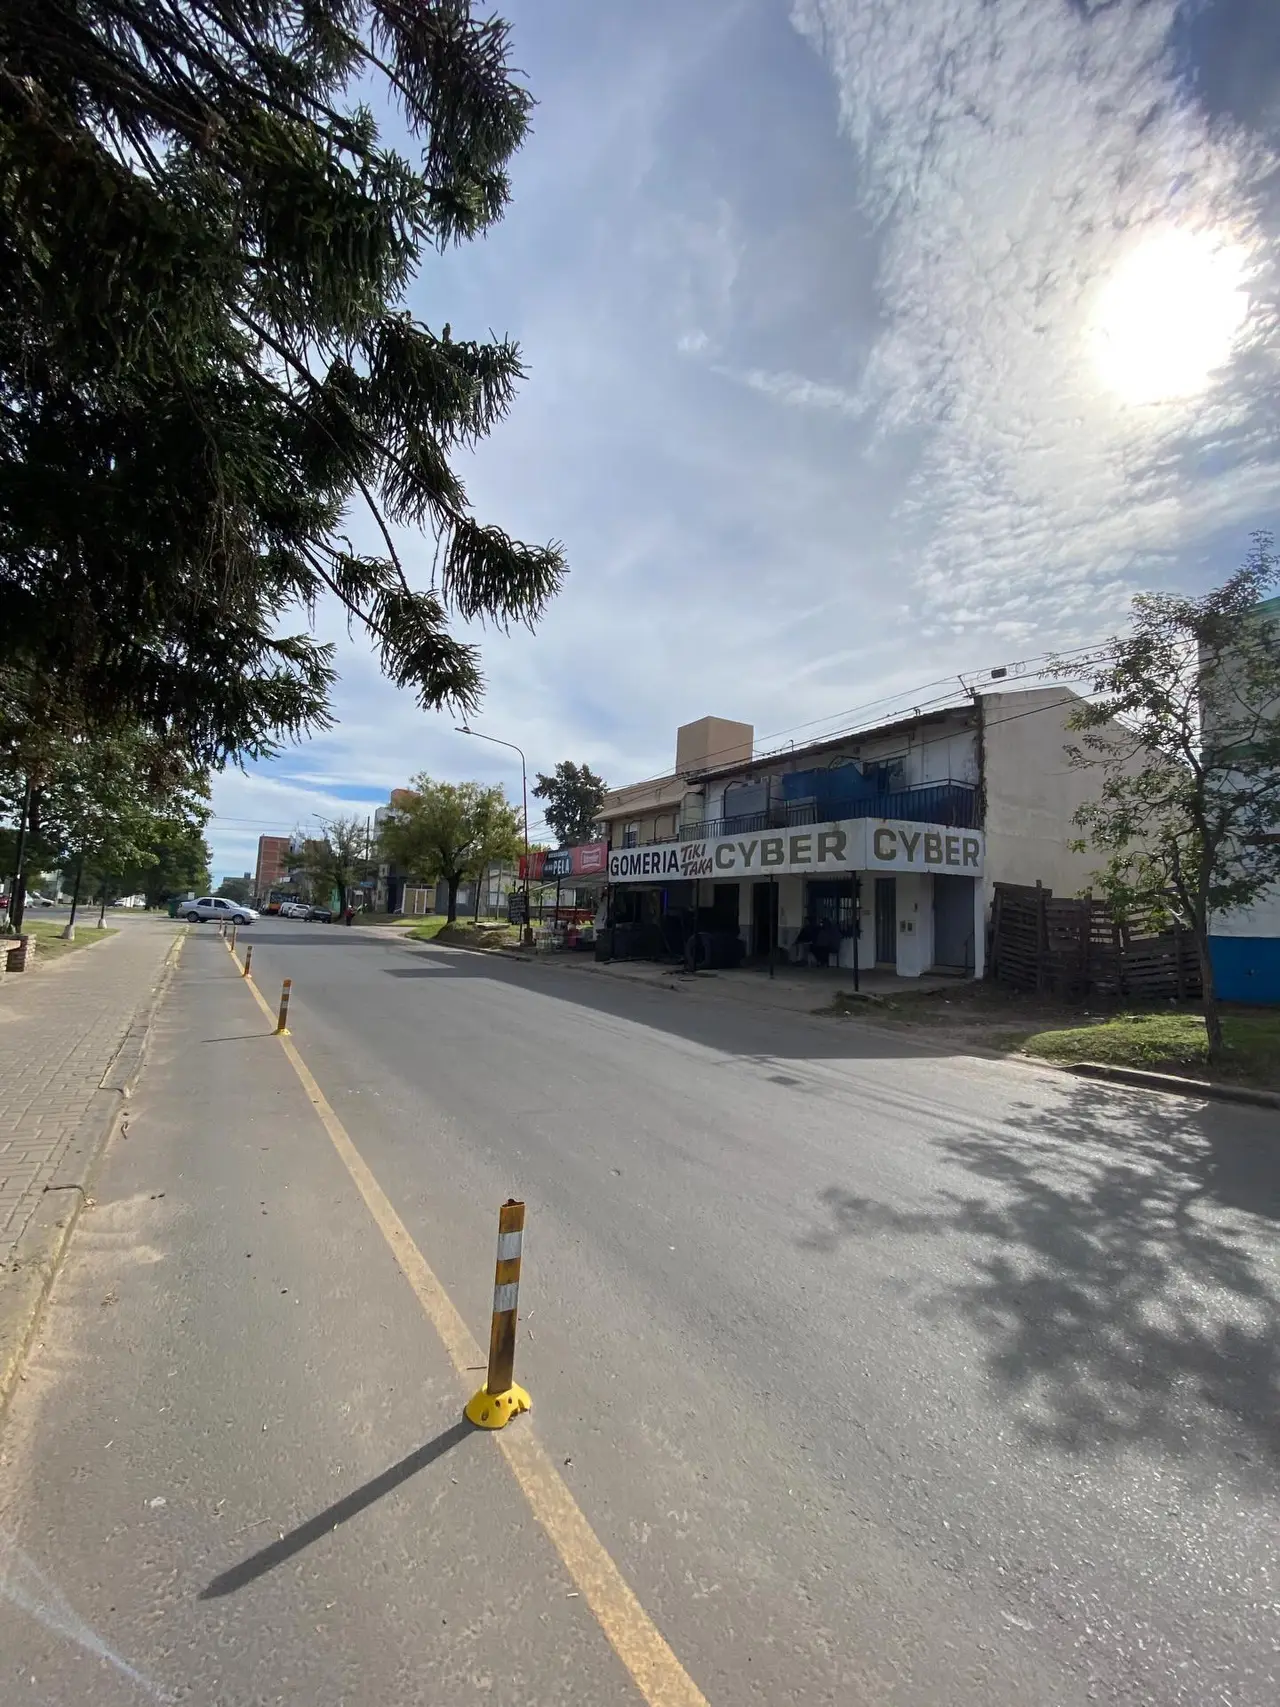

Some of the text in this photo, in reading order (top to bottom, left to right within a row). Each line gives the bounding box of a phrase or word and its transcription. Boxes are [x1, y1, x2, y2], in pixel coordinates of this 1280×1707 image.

[680, 843, 706, 863] TIKI
[715, 831, 847, 870] CYBER
[873, 828, 979, 867] CYBER
[553, 859, 570, 875] PELA
[610, 850, 679, 877] GOMERIA
[680, 857, 713, 876] TAKA
